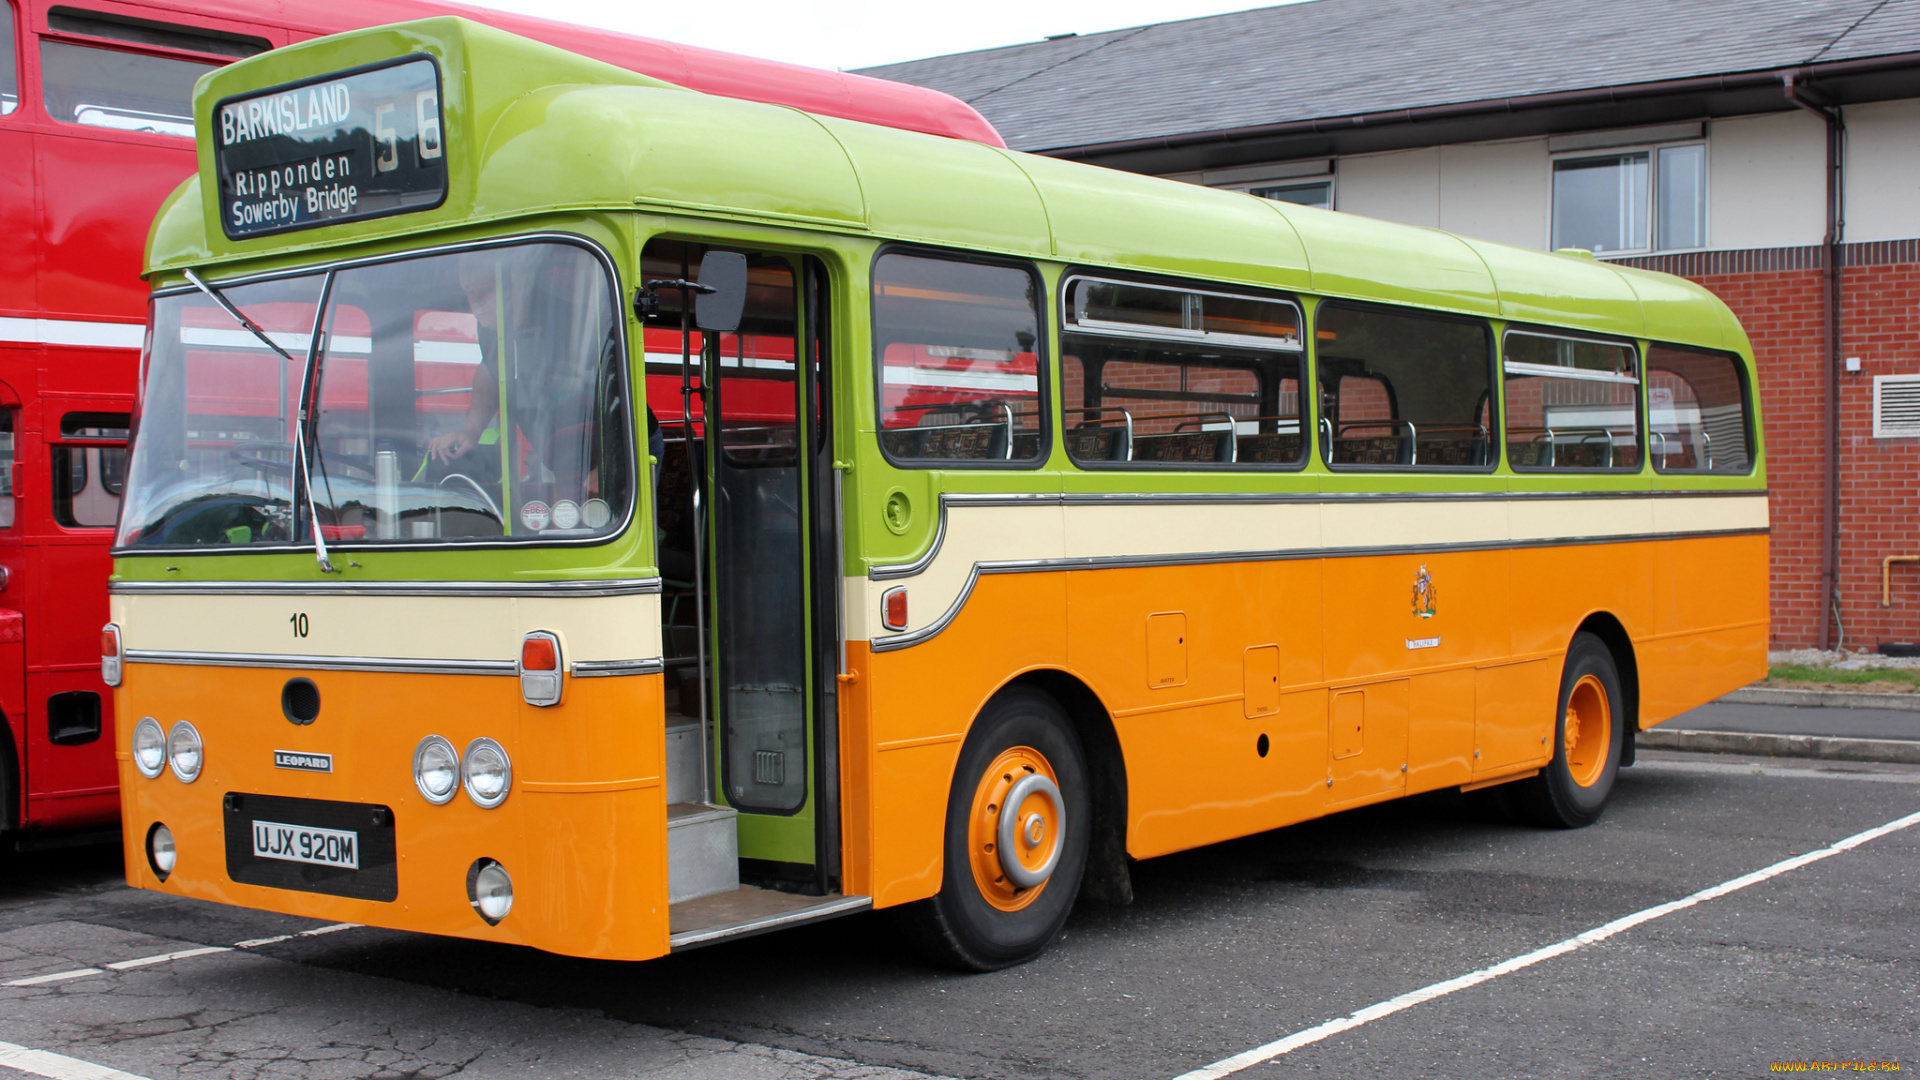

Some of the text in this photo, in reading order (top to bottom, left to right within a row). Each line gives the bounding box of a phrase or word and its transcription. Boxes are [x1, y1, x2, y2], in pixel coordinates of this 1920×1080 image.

[221, 83, 350, 146] BARKISLAND
[236, 155, 350, 199] Ripponden
[232, 183, 358, 227] Sowerby Bridge
[289, 612, 309, 638] 10
[276, 754, 329, 769] LEOPARD
[256, 825, 355, 864] UJX 920M
